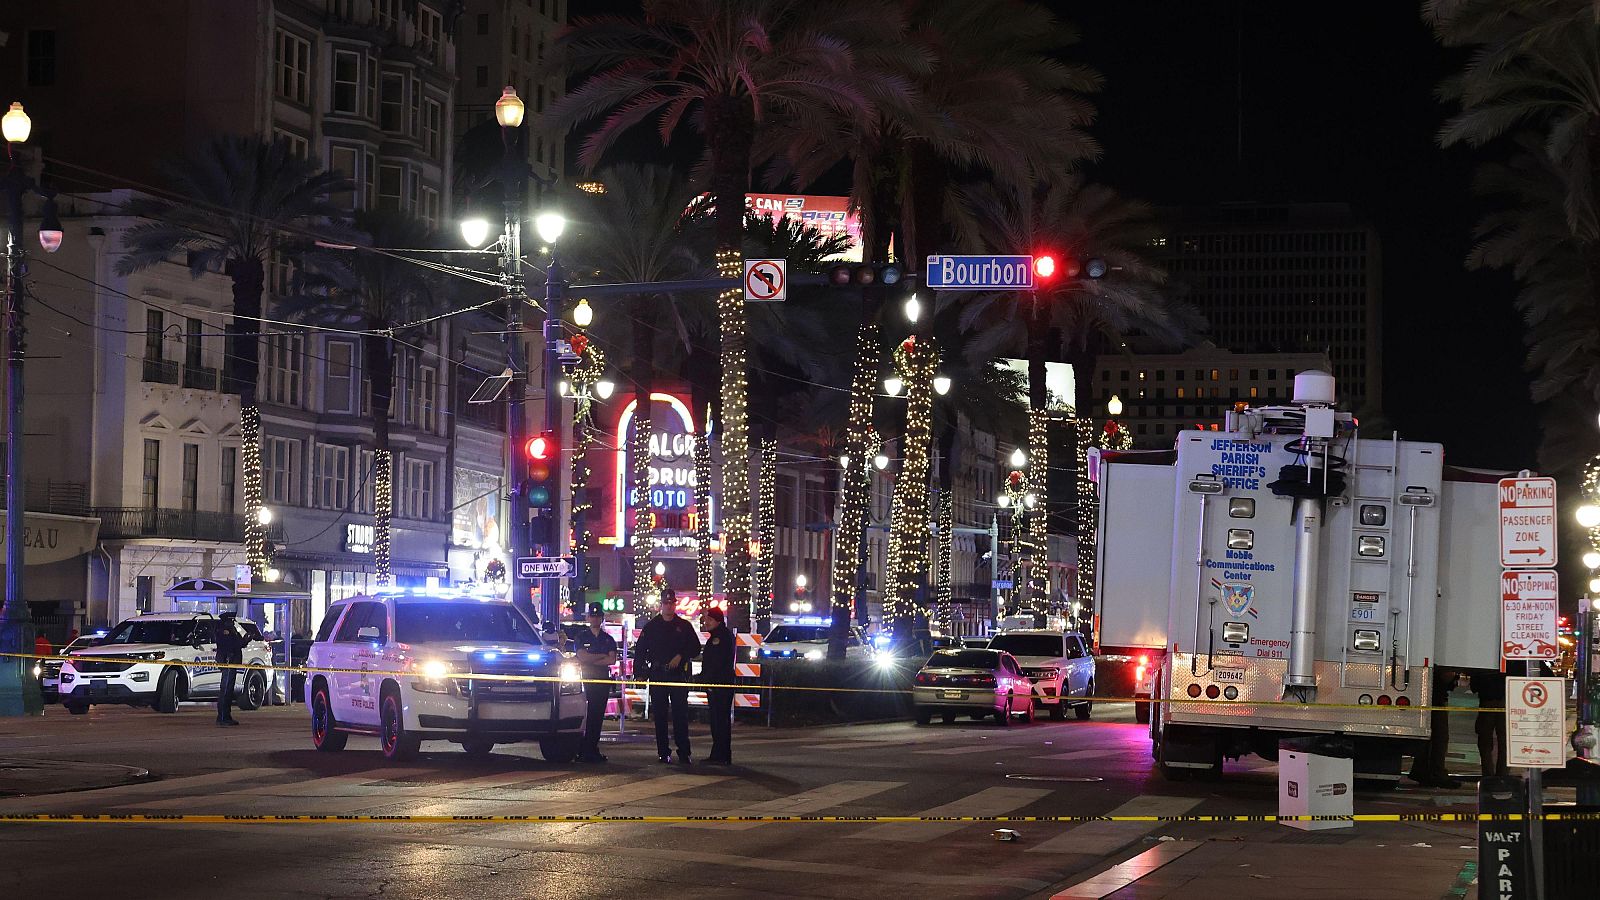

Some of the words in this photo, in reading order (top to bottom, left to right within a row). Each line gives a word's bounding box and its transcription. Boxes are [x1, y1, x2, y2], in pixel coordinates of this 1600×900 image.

[756, 198, 782, 211] CAN
[943, 258, 1027, 284] Bourbon
[1211, 440, 1272, 453] JEFFERSON
[1221, 452, 1259, 465] PARISH
[1212, 464, 1266, 478] SHERIFF'S
[1222, 477, 1259, 490] OFFICE
[630, 490, 687, 507] POTO
[1501, 486, 1516, 503] NO
[1517, 486, 1553, 499] PARKING
[1503, 516, 1553, 526] PASSENGER
[1515, 532, 1540, 541] ZONE
[1226, 550, 1253, 560] Mobile
[524, 564, 540, 572] ONE
[543, 563, 559, 572] WAY
[1206, 559, 1275, 571] Communications
[1224, 571, 1252, 580] Center
[1503, 578, 1518, 594] NO
[1518, 581, 1556, 592] STOPPING
[1522, 602, 1554, 611] AM-NOON
[1250, 637, 1291, 649] Emergency
[1257, 648, 1270, 657] Dial
[1271, 649, 1283, 657] 911
[1218, 671, 1243, 680] 209642
[1485, 831, 1521, 843] VALET
